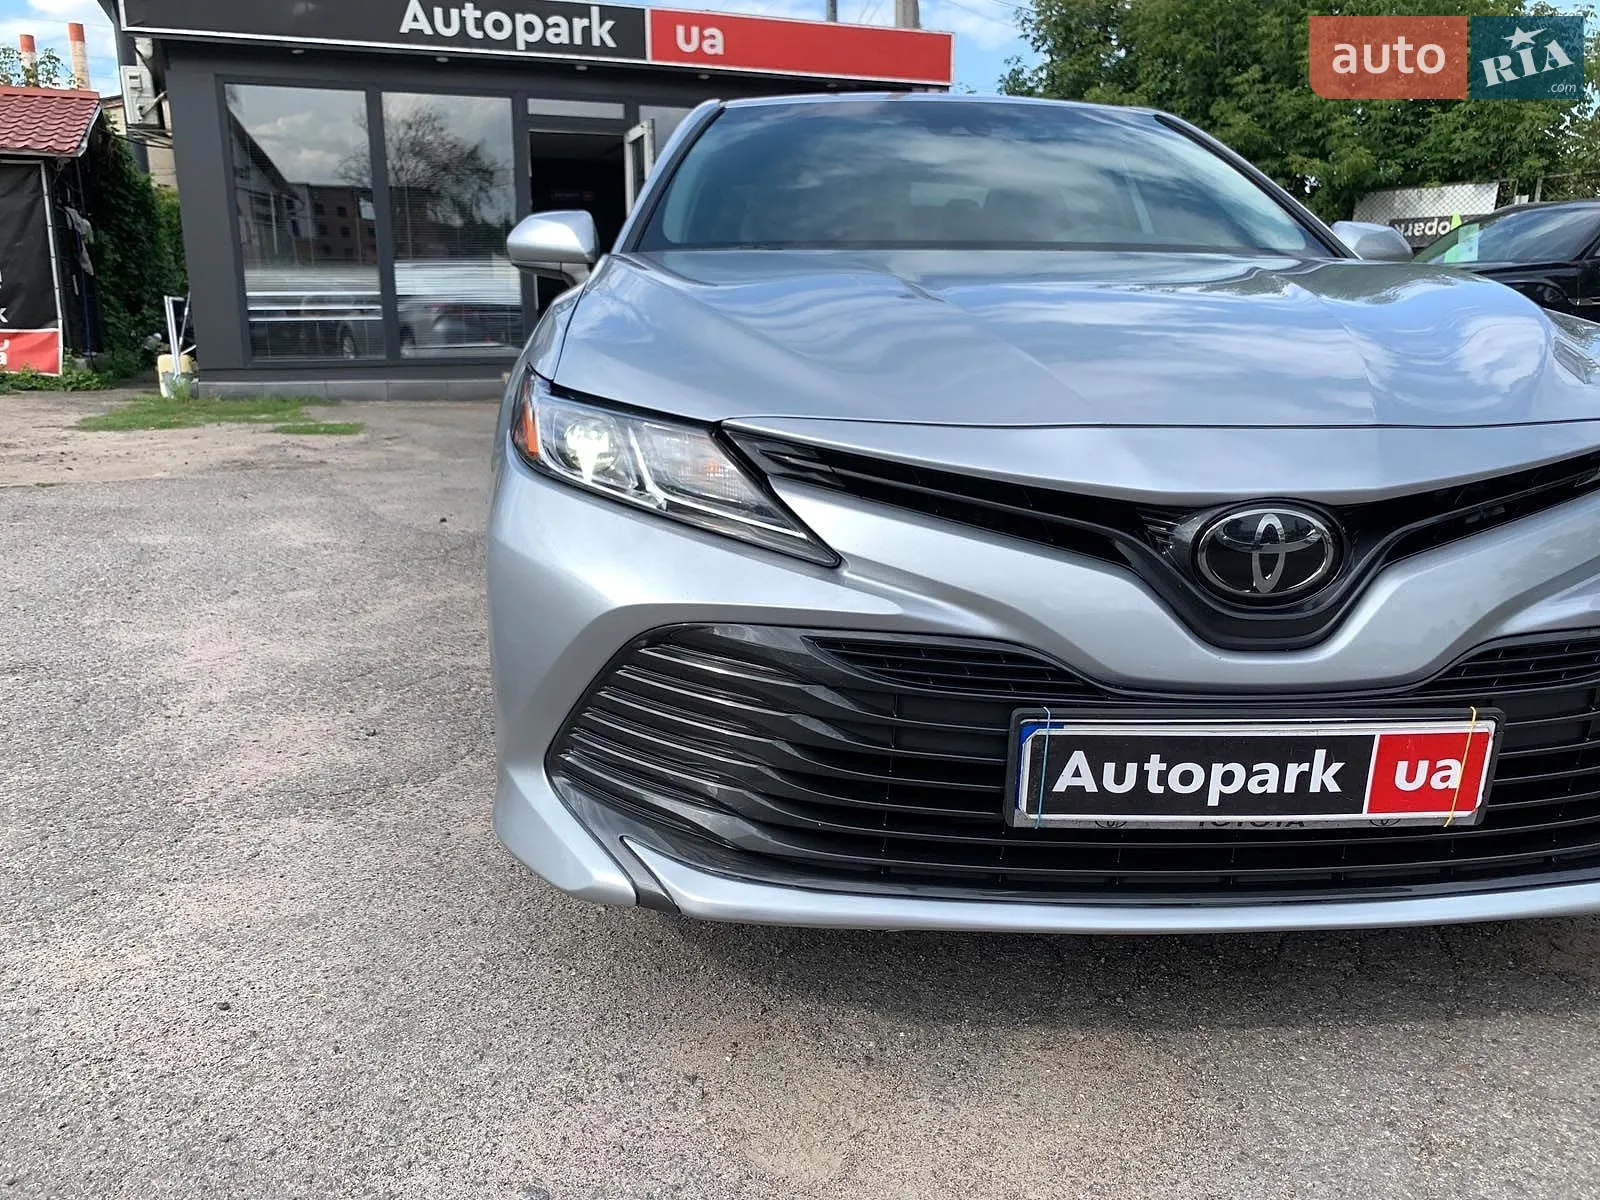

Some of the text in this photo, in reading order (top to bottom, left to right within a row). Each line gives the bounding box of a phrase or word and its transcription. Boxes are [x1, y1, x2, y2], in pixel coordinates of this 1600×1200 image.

[400, 0, 725, 55] Autopark ua
[1052, 748, 1463, 807] Autopark ua
